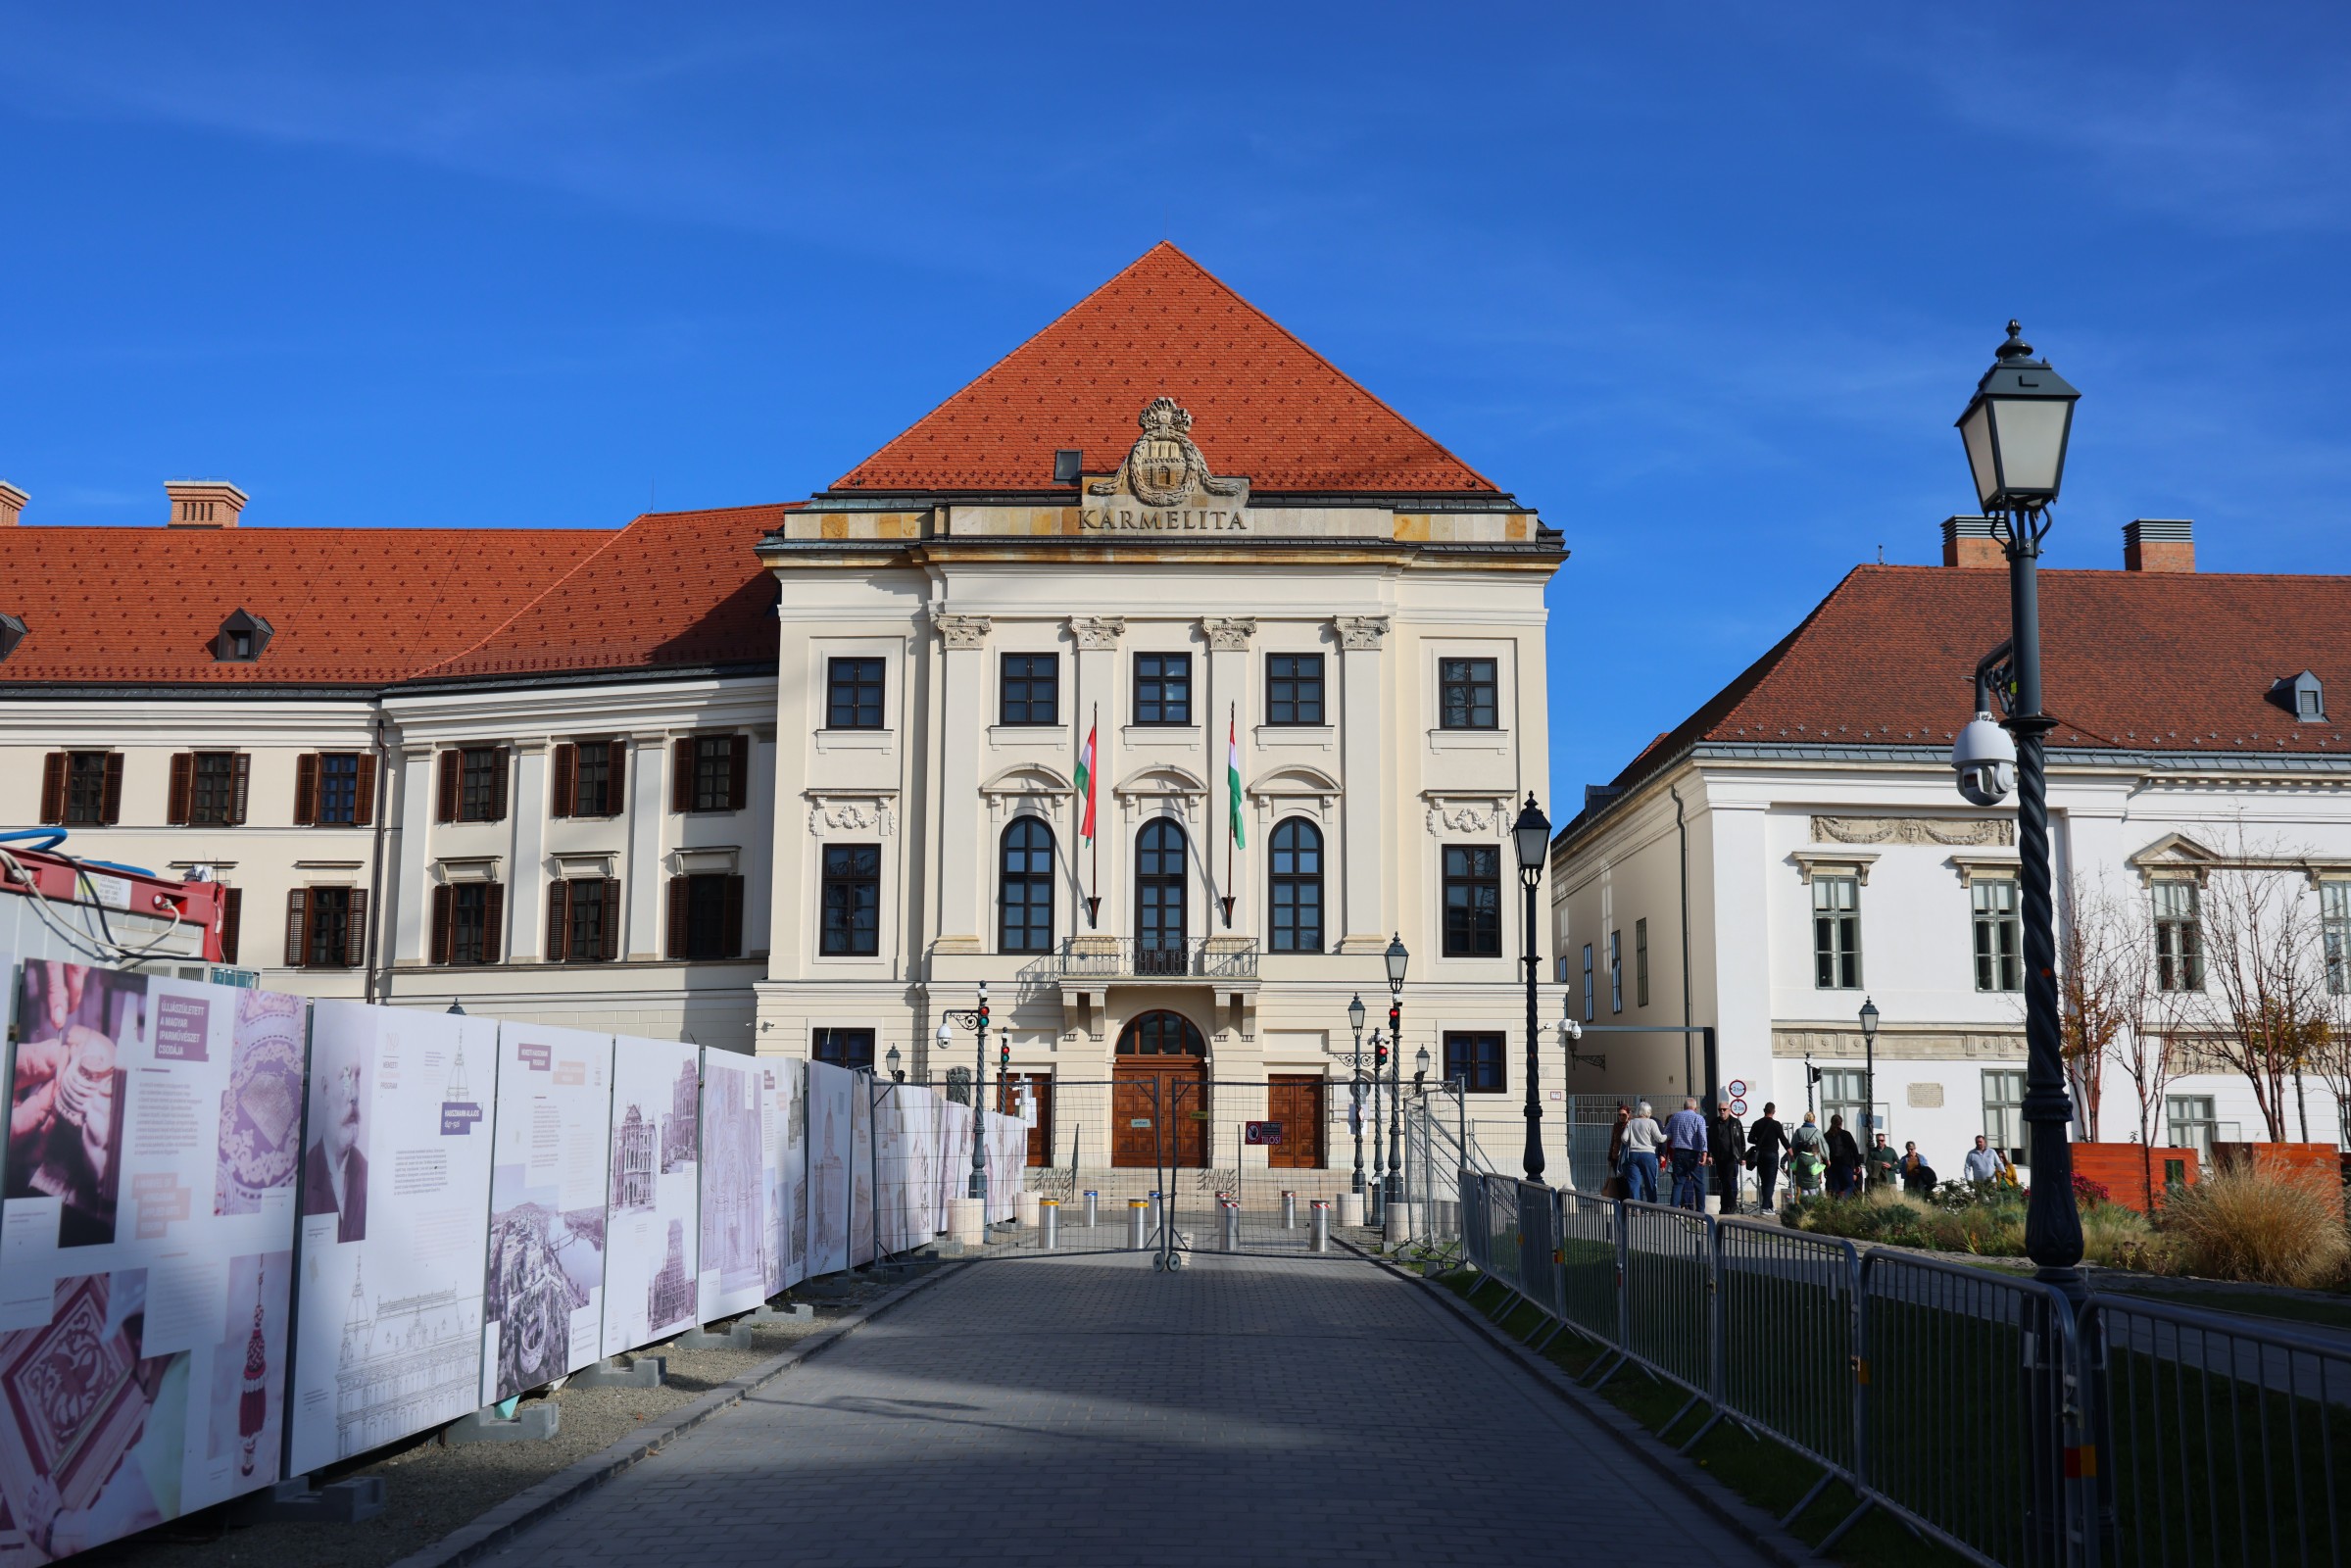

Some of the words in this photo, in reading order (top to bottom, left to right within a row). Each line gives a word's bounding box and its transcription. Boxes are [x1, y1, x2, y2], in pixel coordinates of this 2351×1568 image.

[1078, 510, 1248, 530] KARMELITA
[165, 1016, 188, 1028] MAGYAR
[158, 1044, 184, 1055] CSODÁJA
[1261, 1136, 1281, 1145] TILOS!
